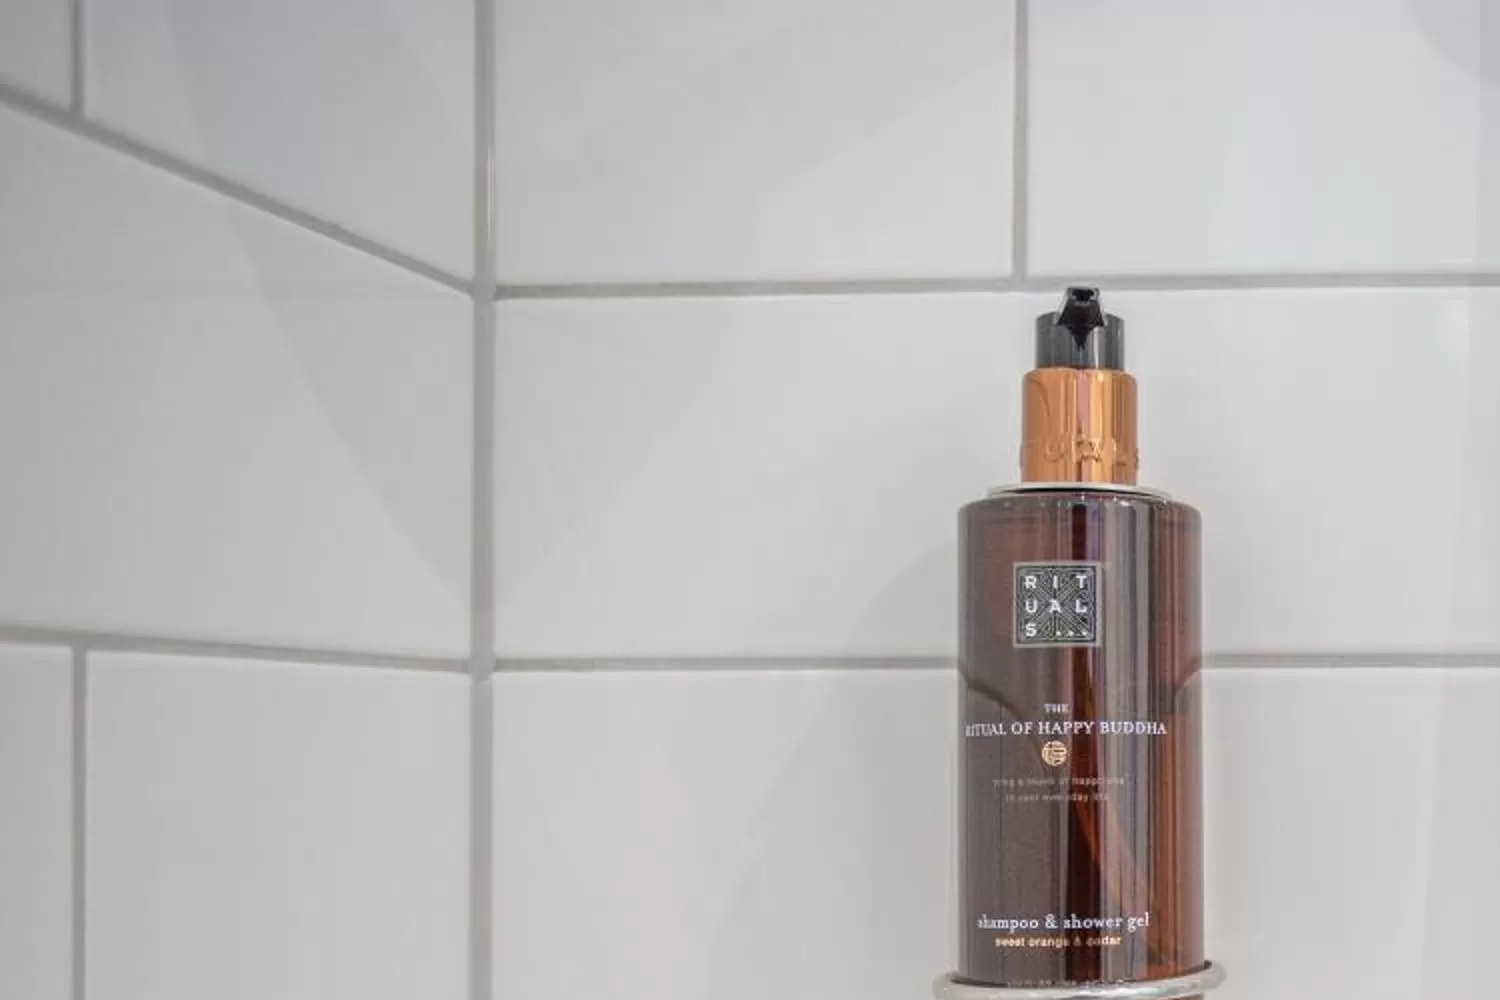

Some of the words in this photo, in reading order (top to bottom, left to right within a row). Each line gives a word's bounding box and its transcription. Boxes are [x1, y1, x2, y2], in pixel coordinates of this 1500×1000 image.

[1044, 703, 1069, 714] THE
[1011, 721, 1032, 735] OF
[1038, 721, 1094, 735] HAPPY
[1100, 721, 1167, 735] BUDDHA
[977, 914, 1038, 933] shampoo
[1045, 914, 1057, 929] &
[1063, 913, 1122, 929] shower
[1127, 912, 1149, 931] gel
[995, 937, 1025, 947] sweet
[1029, 937, 1069, 949] orange
